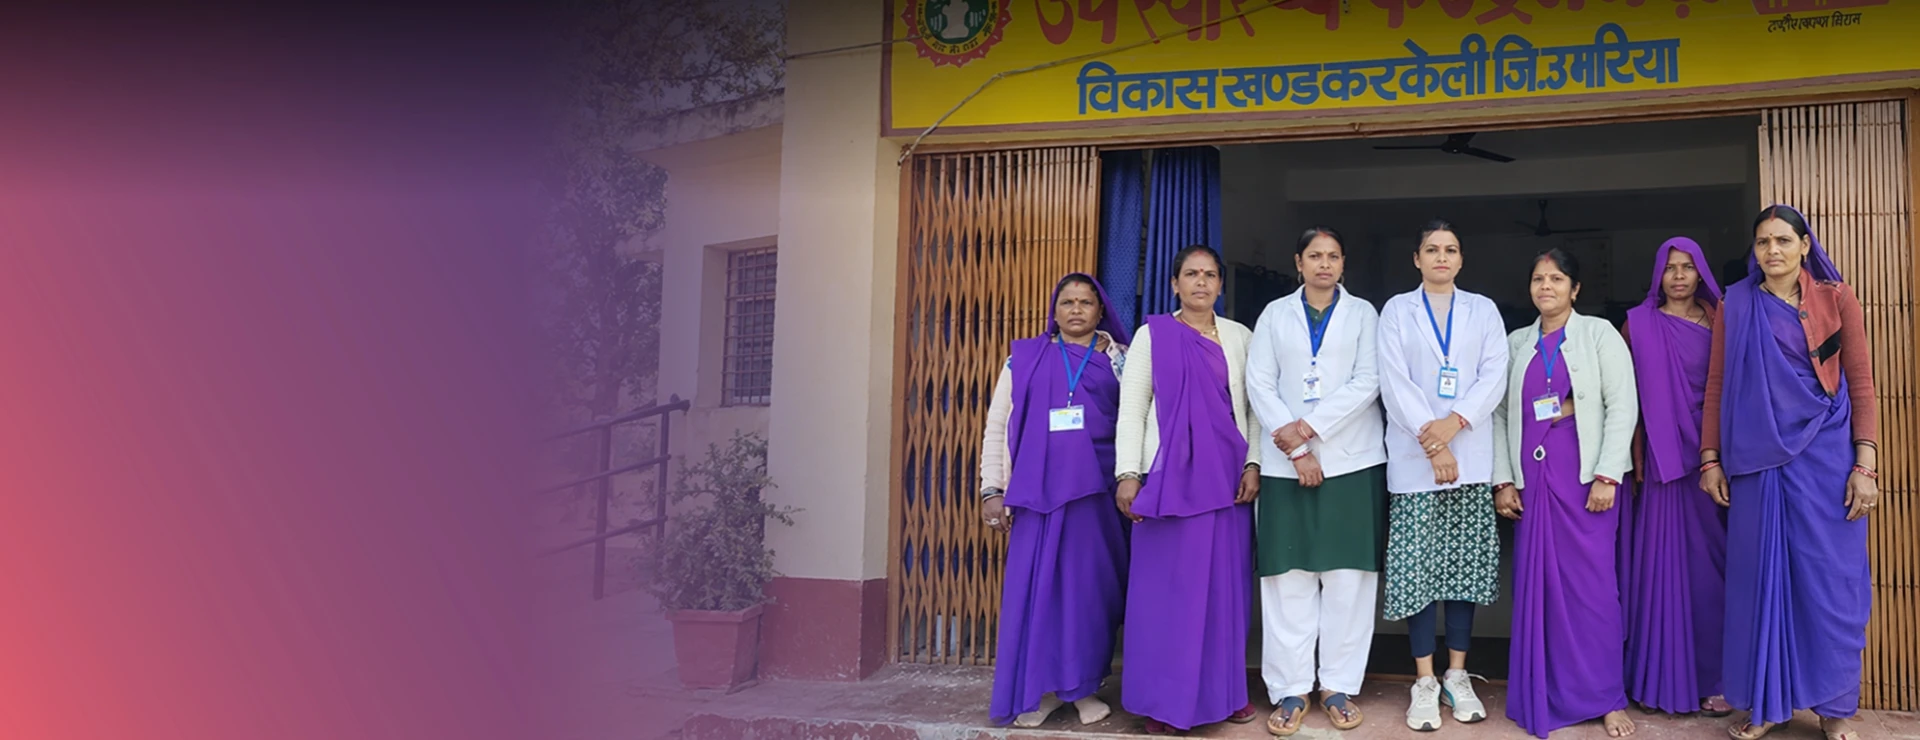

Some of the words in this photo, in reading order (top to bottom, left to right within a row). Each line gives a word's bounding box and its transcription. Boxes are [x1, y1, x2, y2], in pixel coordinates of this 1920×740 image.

[1077, 61, 1219, 114] विकास
[1222, 63, 1321, 107] खण्ड
[1322, 34, 1490, 102] करकेली
[1541, 22, 1680, 89] उमरिया
